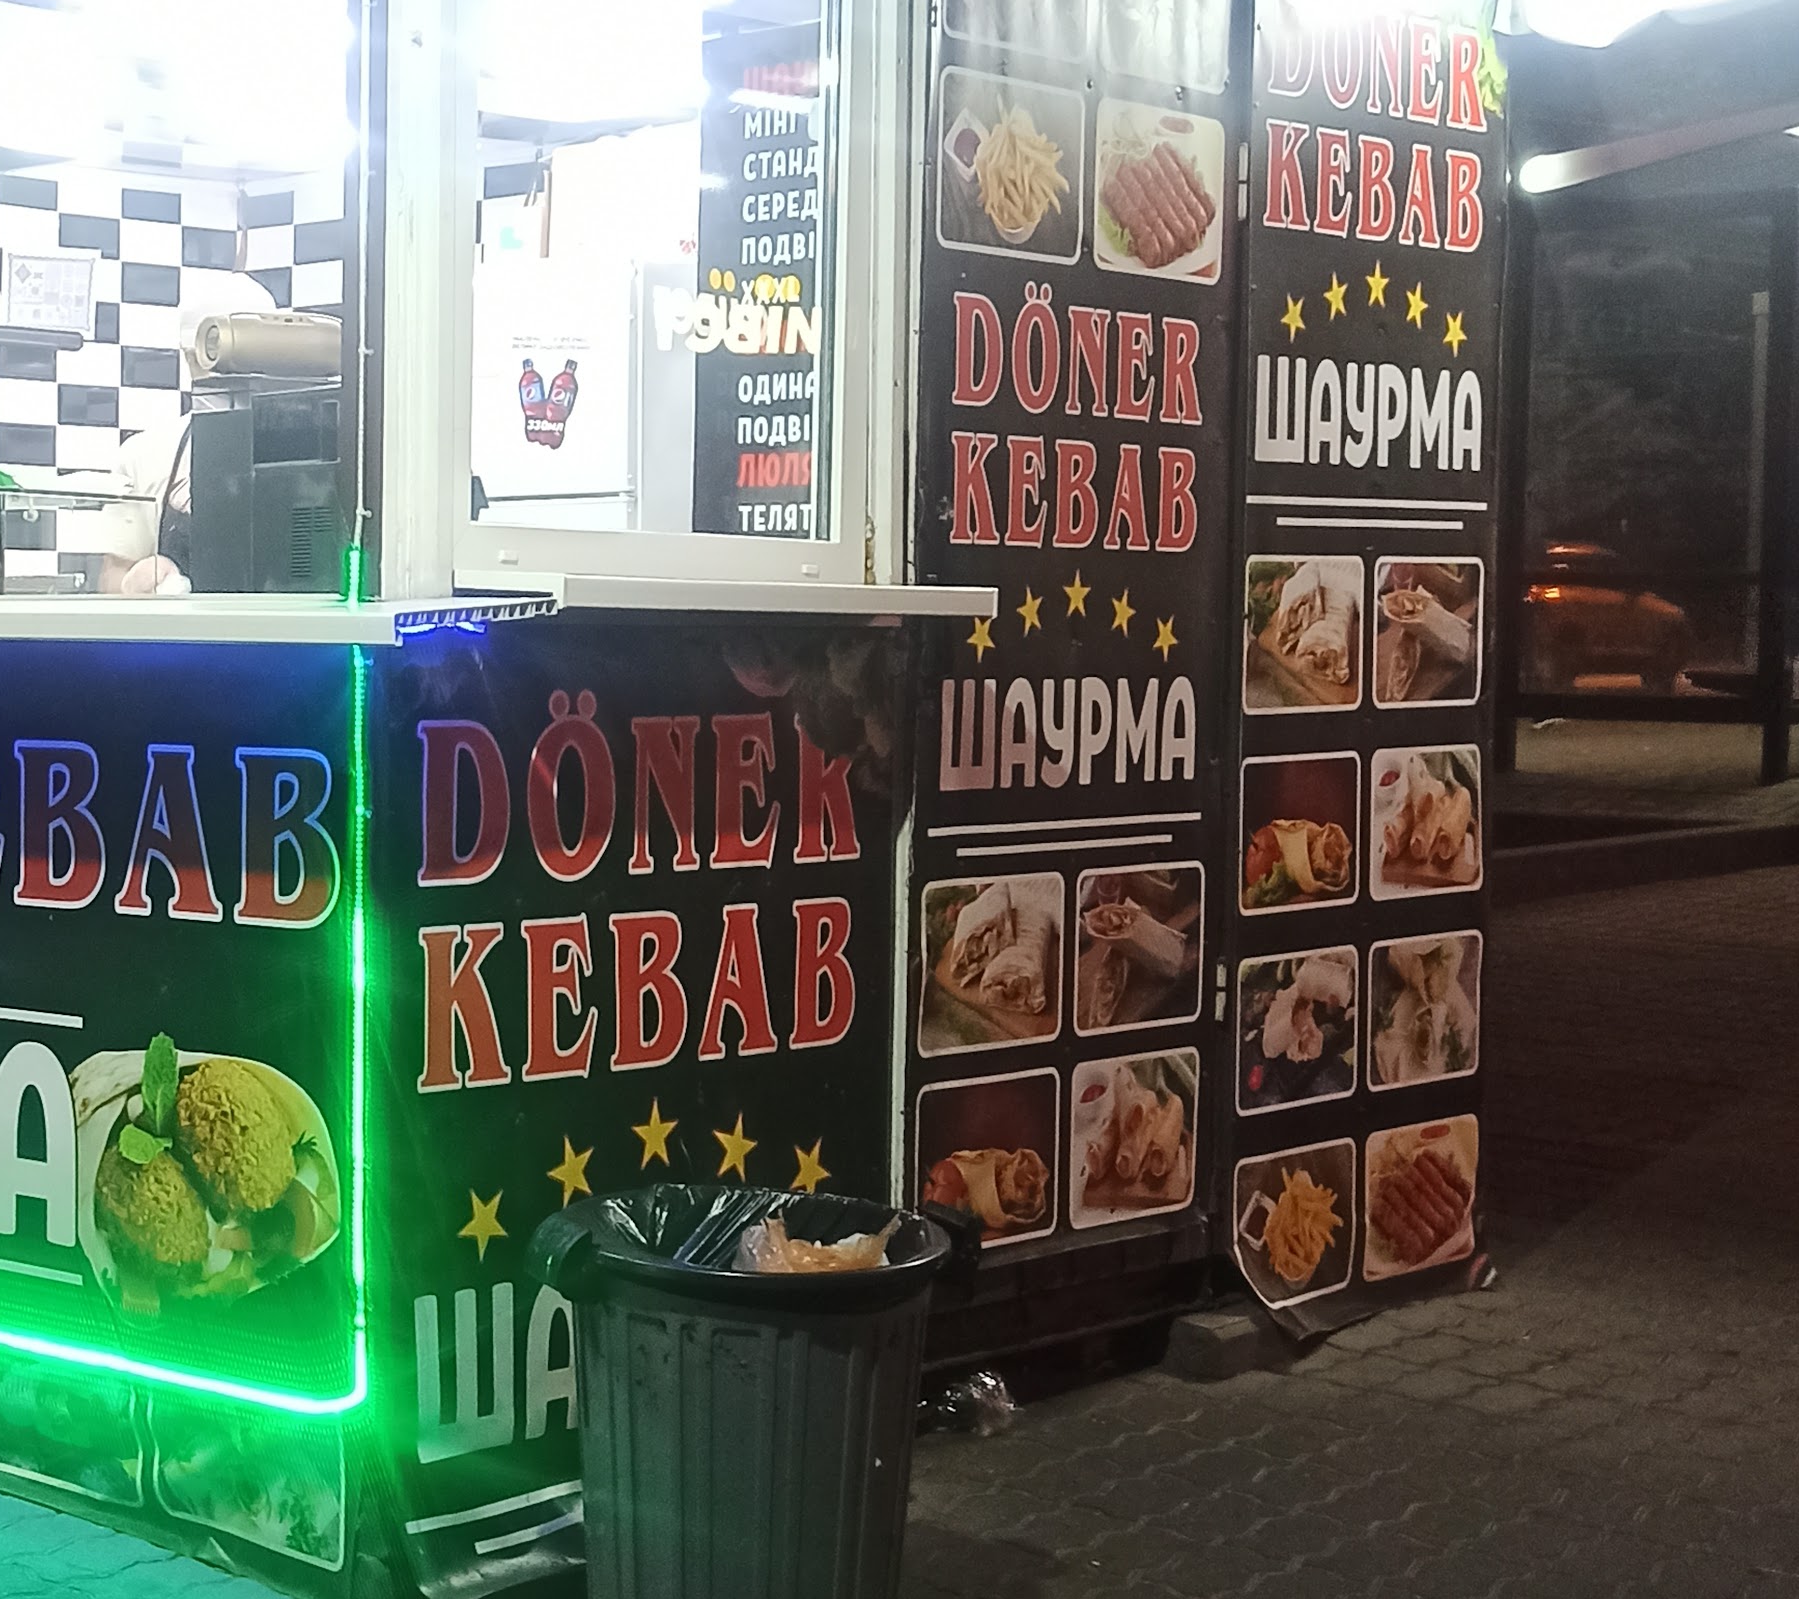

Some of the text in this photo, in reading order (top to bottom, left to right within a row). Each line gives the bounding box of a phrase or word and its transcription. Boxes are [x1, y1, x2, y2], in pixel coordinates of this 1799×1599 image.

[1264, 118, 1485, 254] KEBAB
[952, 281, 1202, 427] DÖNER
[1255, 353, 1483, 474] ШАУРМА
[950, 430, 1200, 553] KEBAB
[416, 688, 861, 888] DÖNER
[940, 676, 1197, 791] ШАУРМА
[416, 897, 857, 1094] KEBAB
